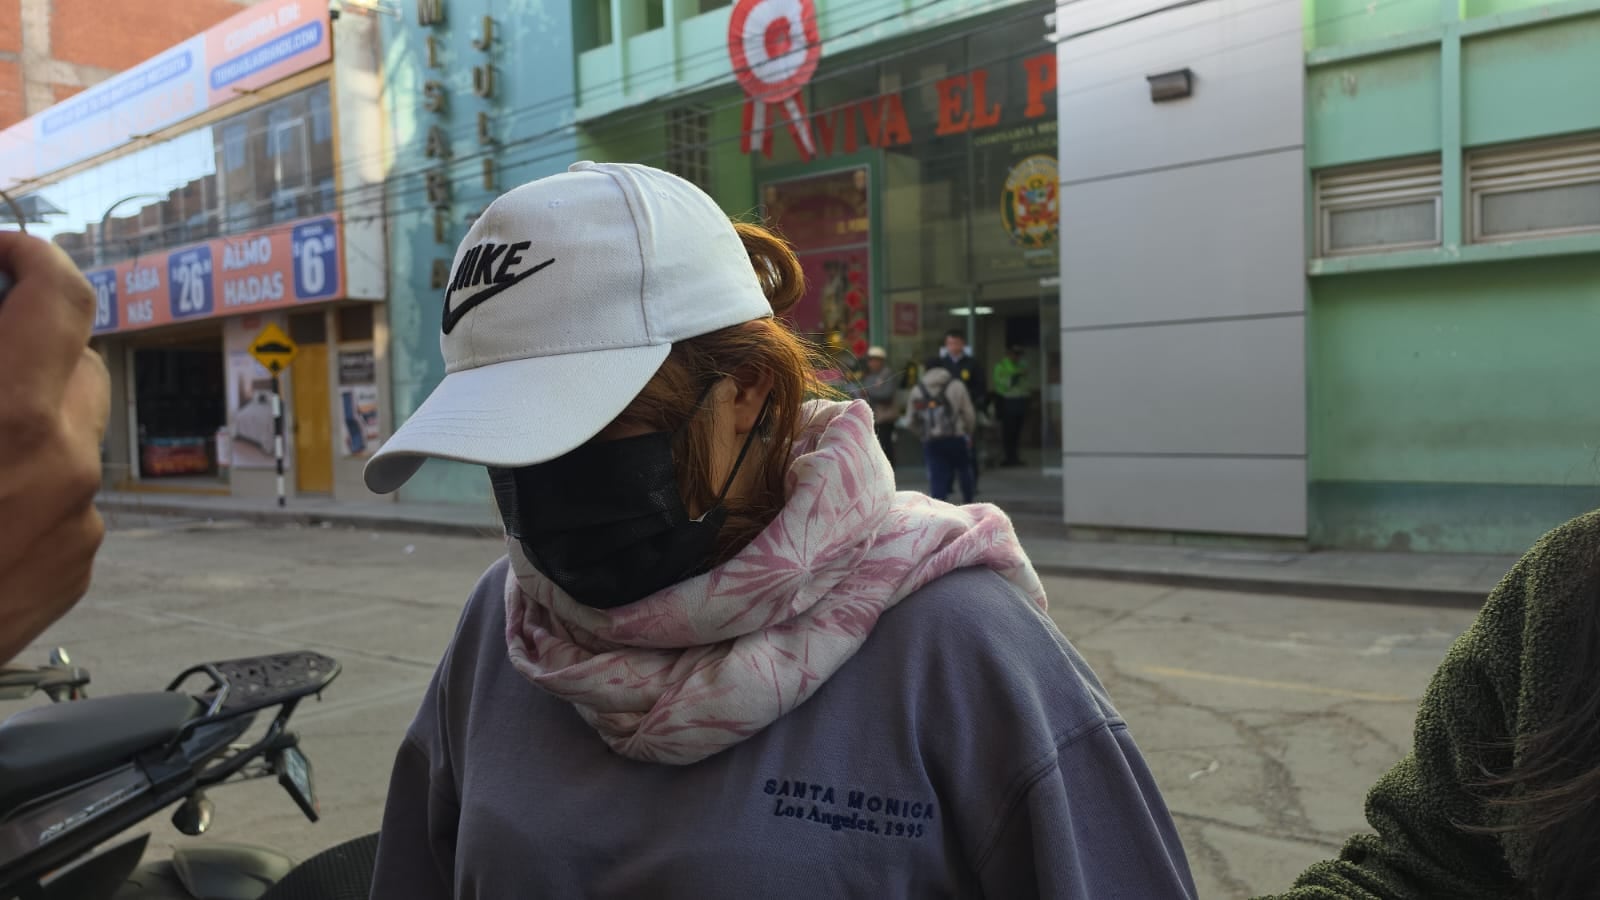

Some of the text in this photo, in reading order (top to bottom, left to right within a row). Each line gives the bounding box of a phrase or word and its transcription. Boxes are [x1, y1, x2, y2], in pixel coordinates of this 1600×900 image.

[471, 15, 495, 213] JULI
[815, 92, 913, 158] VIVA
[934, 68, 1001, 137] EL
[222, 234, 272, 271] ALMO
[302, 237, 326, 294] 6
[451, 241, 531, 292] NIKE
[178, 260, 206, 313] 26
[223, 271, 285, 308] HADAS
[763, 778, 934, 820] SANTA MONICA
[773, 798, 924, 839] Los Angeles, 1995
